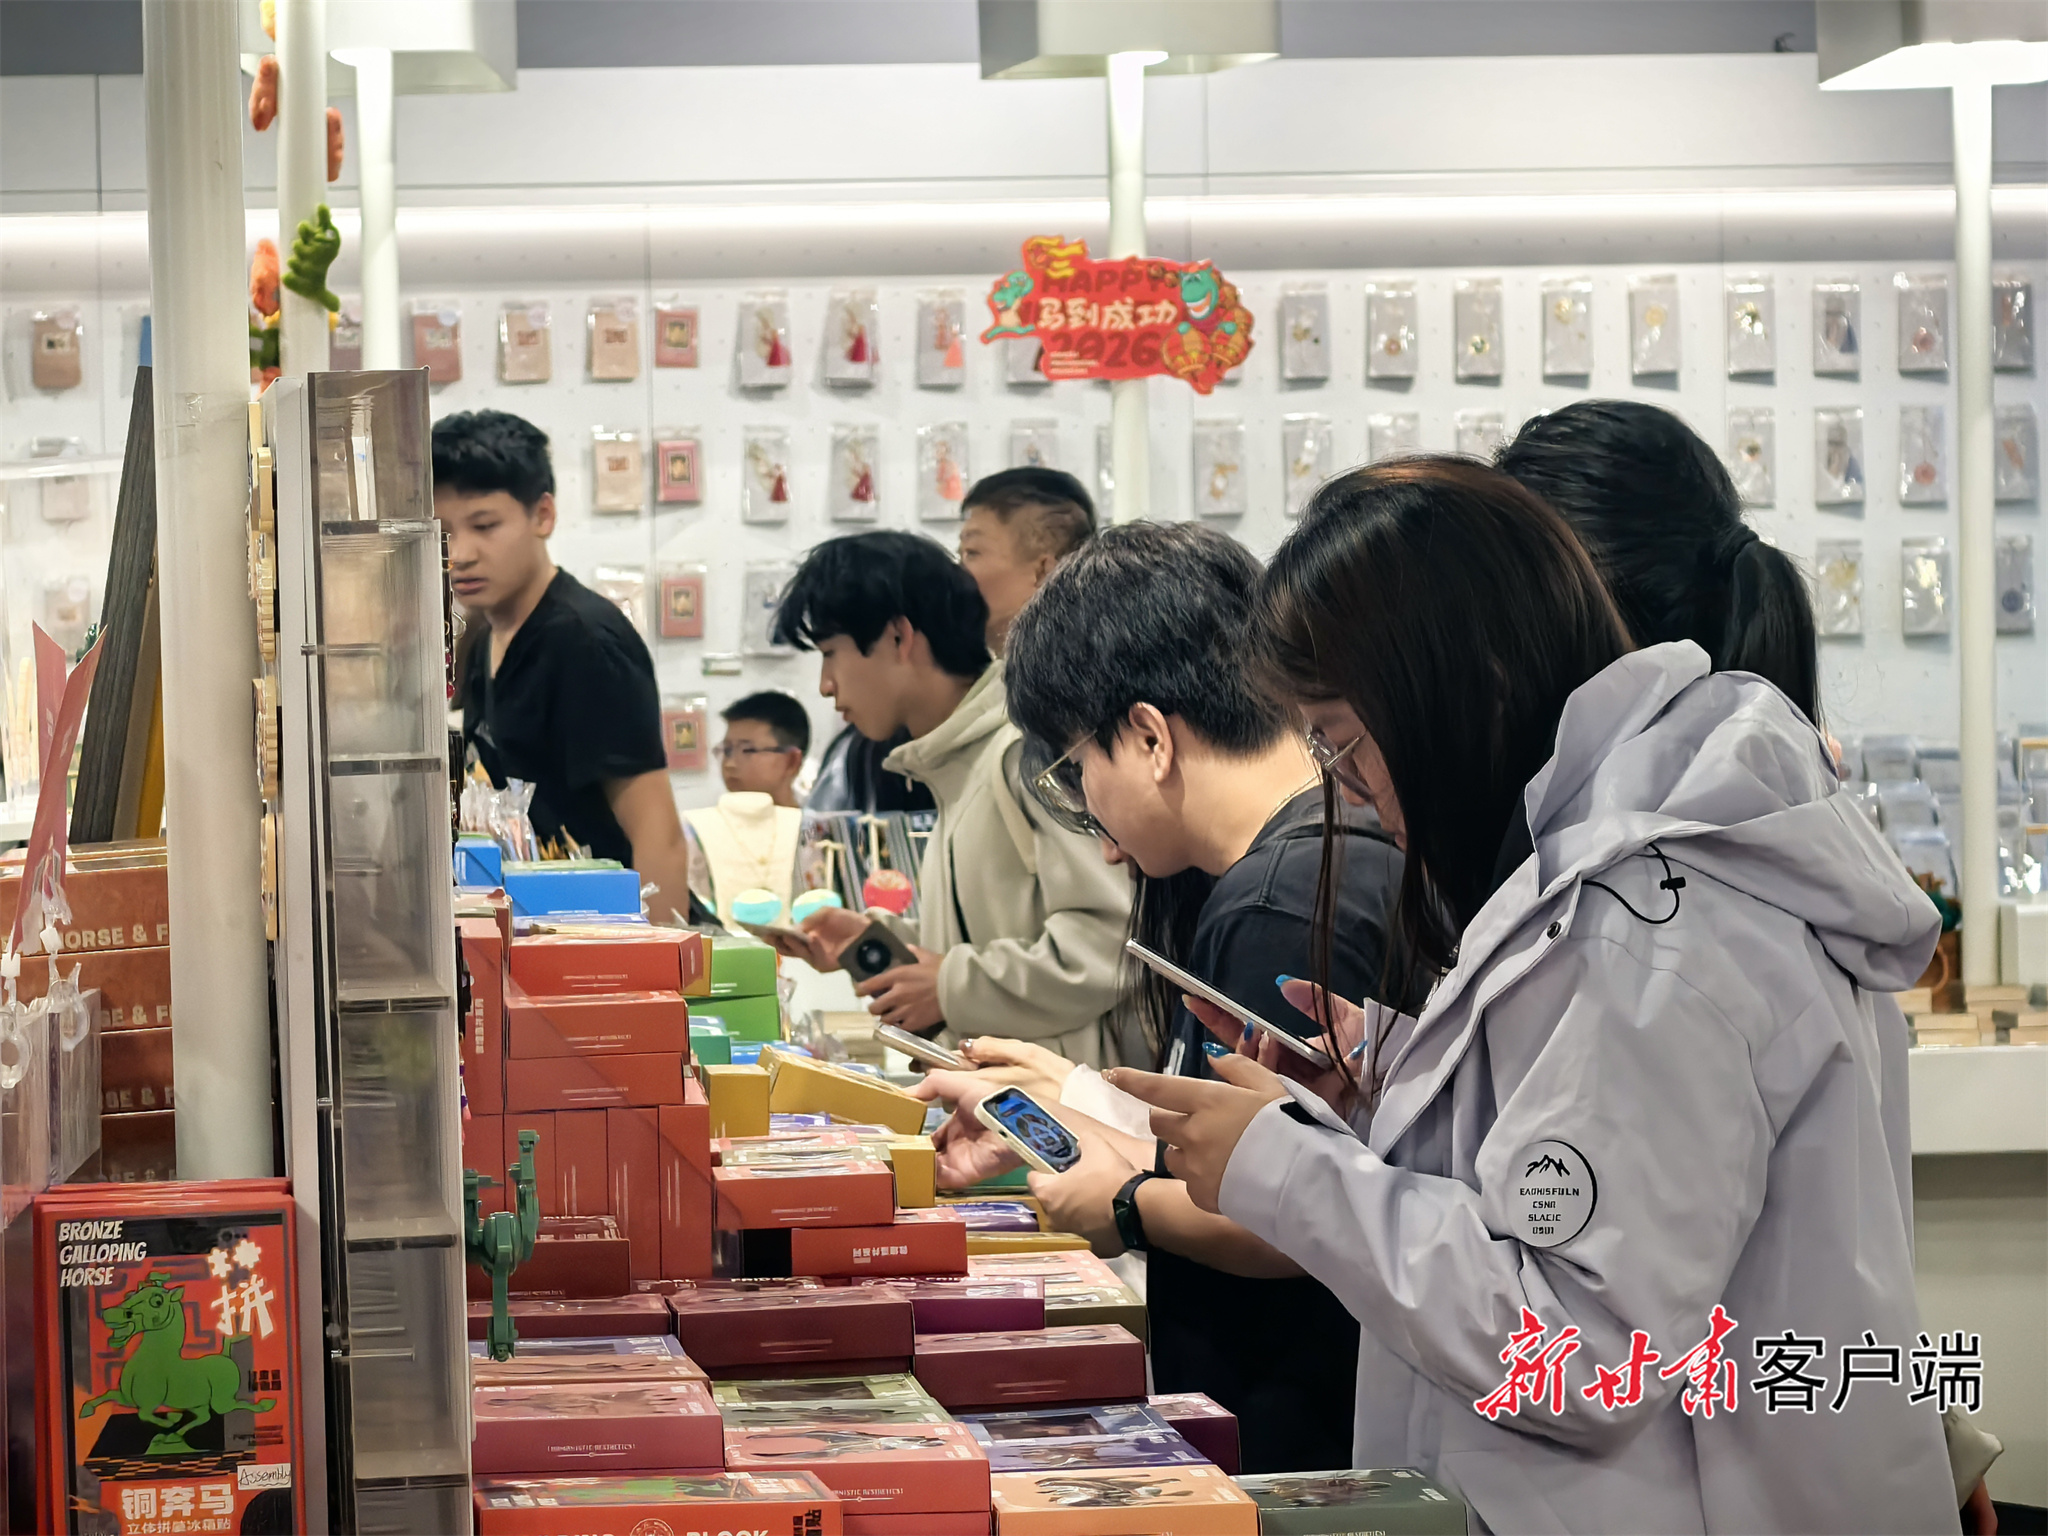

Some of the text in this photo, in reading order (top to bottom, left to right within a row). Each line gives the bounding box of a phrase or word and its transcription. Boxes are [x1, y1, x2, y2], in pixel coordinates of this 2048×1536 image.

[1037, 296, 1178, 331] 马到成功
[59, 1220, 123, 1241] BRONZE
[60, 1242, 147, 1265] GALLOPING
[60, 1267, 114, 1288] HORSE
[211, 1273, 275, 1338] 拼
[238, 1464, 291, 1486] Assembly
[121, 1484, 234, 1520] 铜奔马
